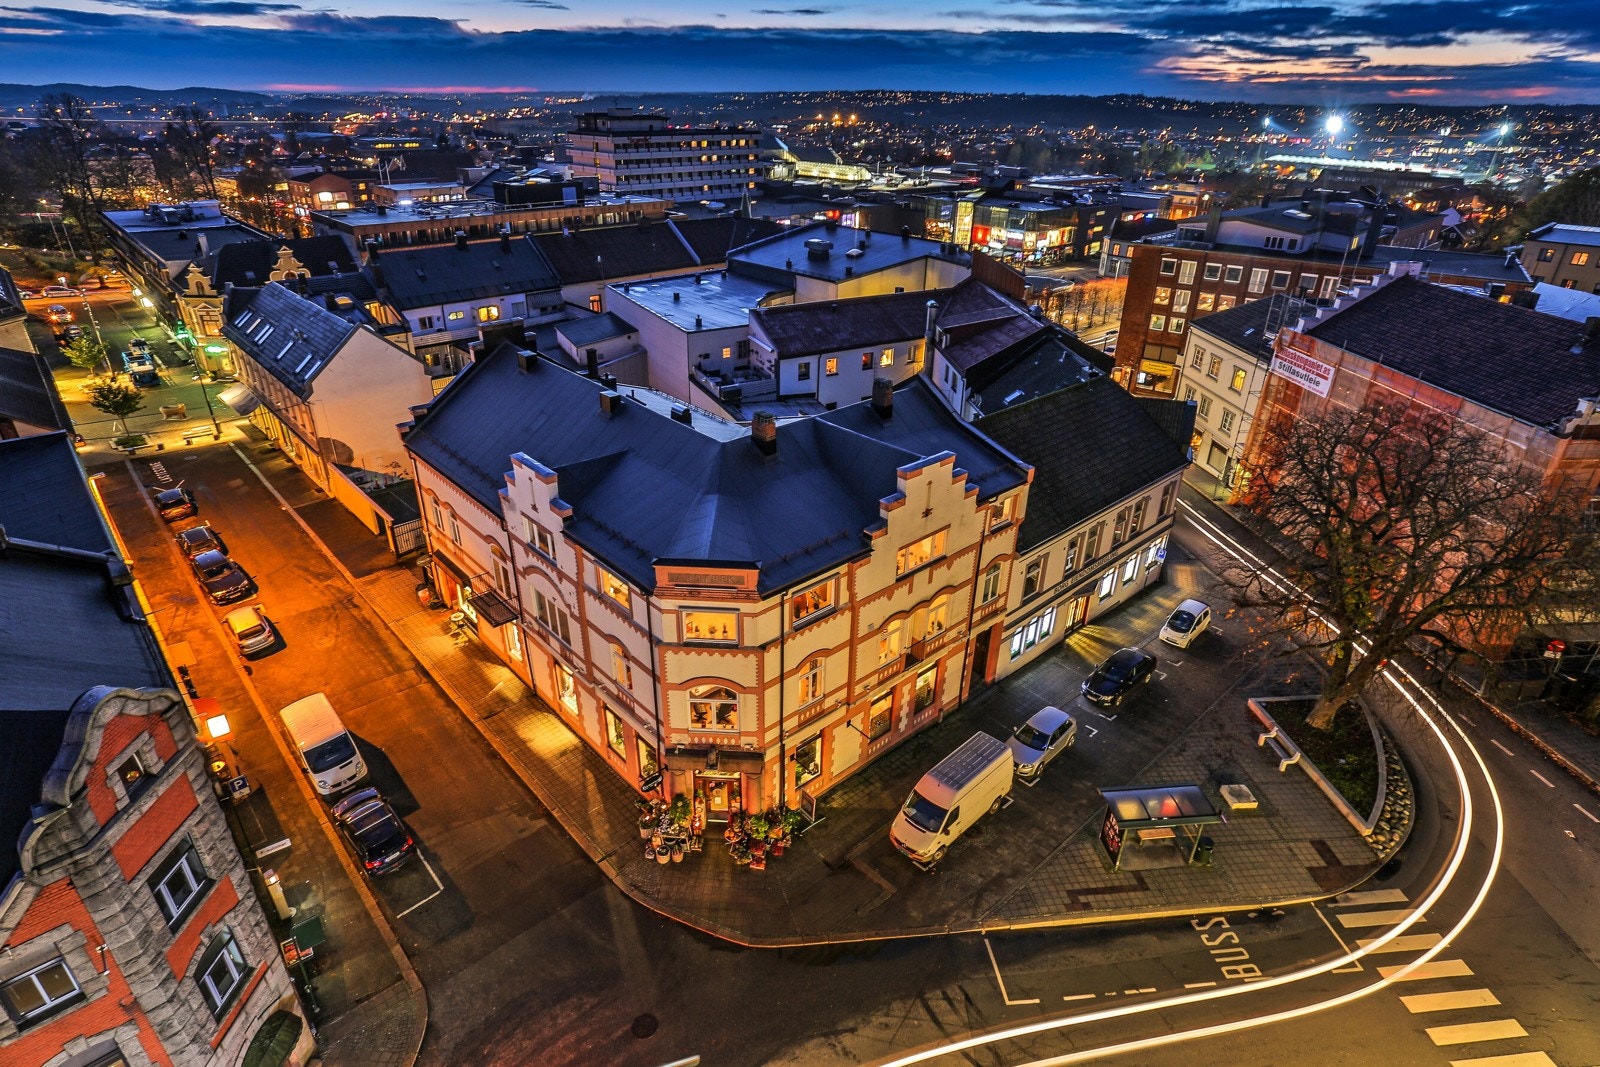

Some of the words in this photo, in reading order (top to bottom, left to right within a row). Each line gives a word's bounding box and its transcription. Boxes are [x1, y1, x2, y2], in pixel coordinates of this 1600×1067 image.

[1278, 361, 1321, 387] Stillasutleie
[233, 780, 243, 791] P
[1190, 916, 1263, 979] BUSS
